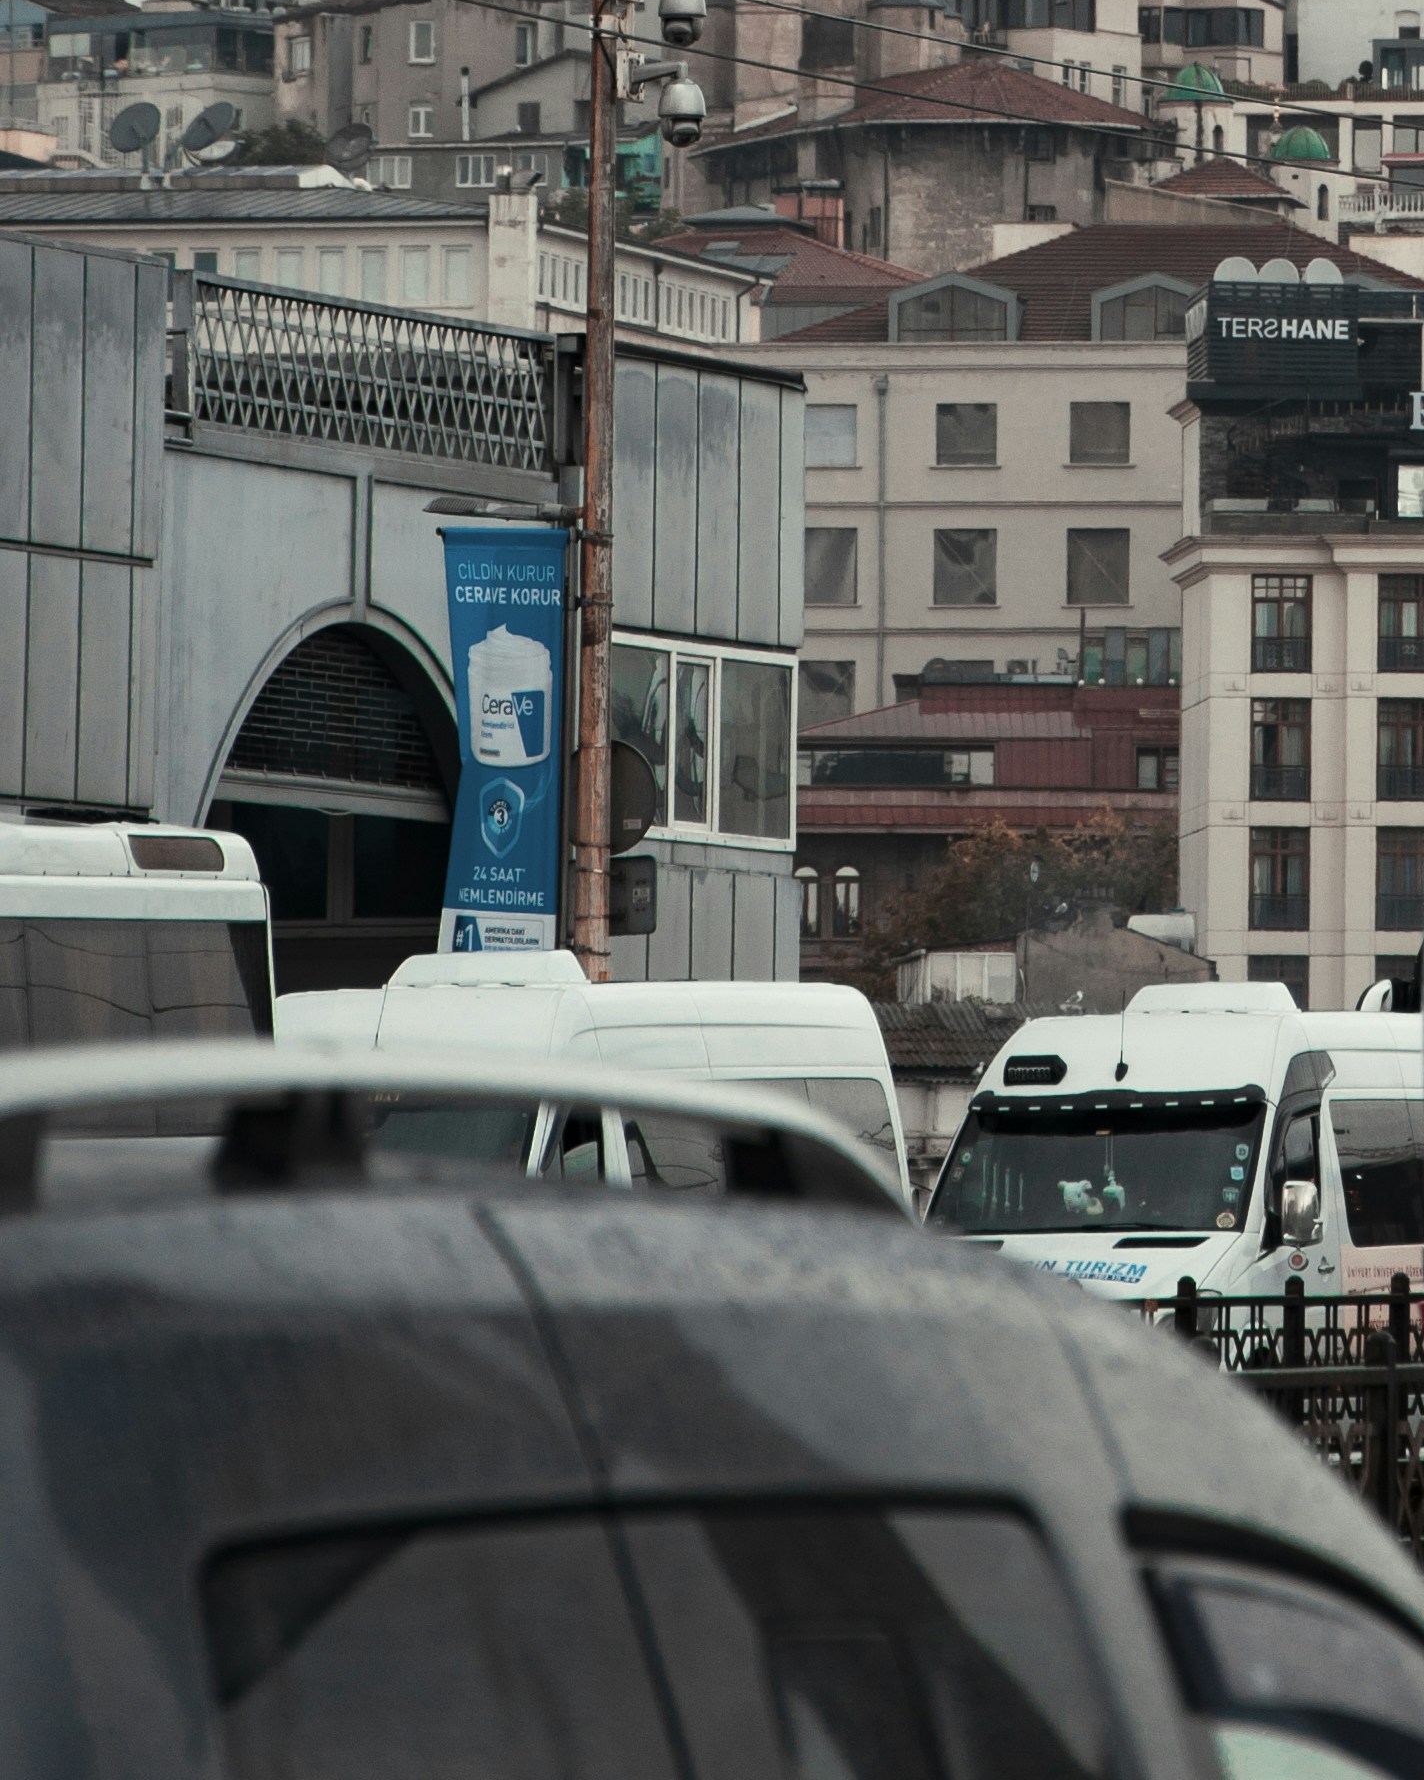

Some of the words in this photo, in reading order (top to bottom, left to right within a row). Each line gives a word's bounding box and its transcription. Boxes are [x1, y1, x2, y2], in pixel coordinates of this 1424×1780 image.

[1217, 317, 1349, 340] TERSHANE
[458, 560, 503, 581] CİLDİN
[507, 565, 555, 582] KURUR
[455, 586, 507, 604] CERAVE
[511, 588, 561, 606] KORUR
[482, 693, 534, 716] CeraVe
[496, 809, 505, 825] 3
[473, 866, 487, 881] 24
[459, 887, 545, 907] NEMLENDİRME
